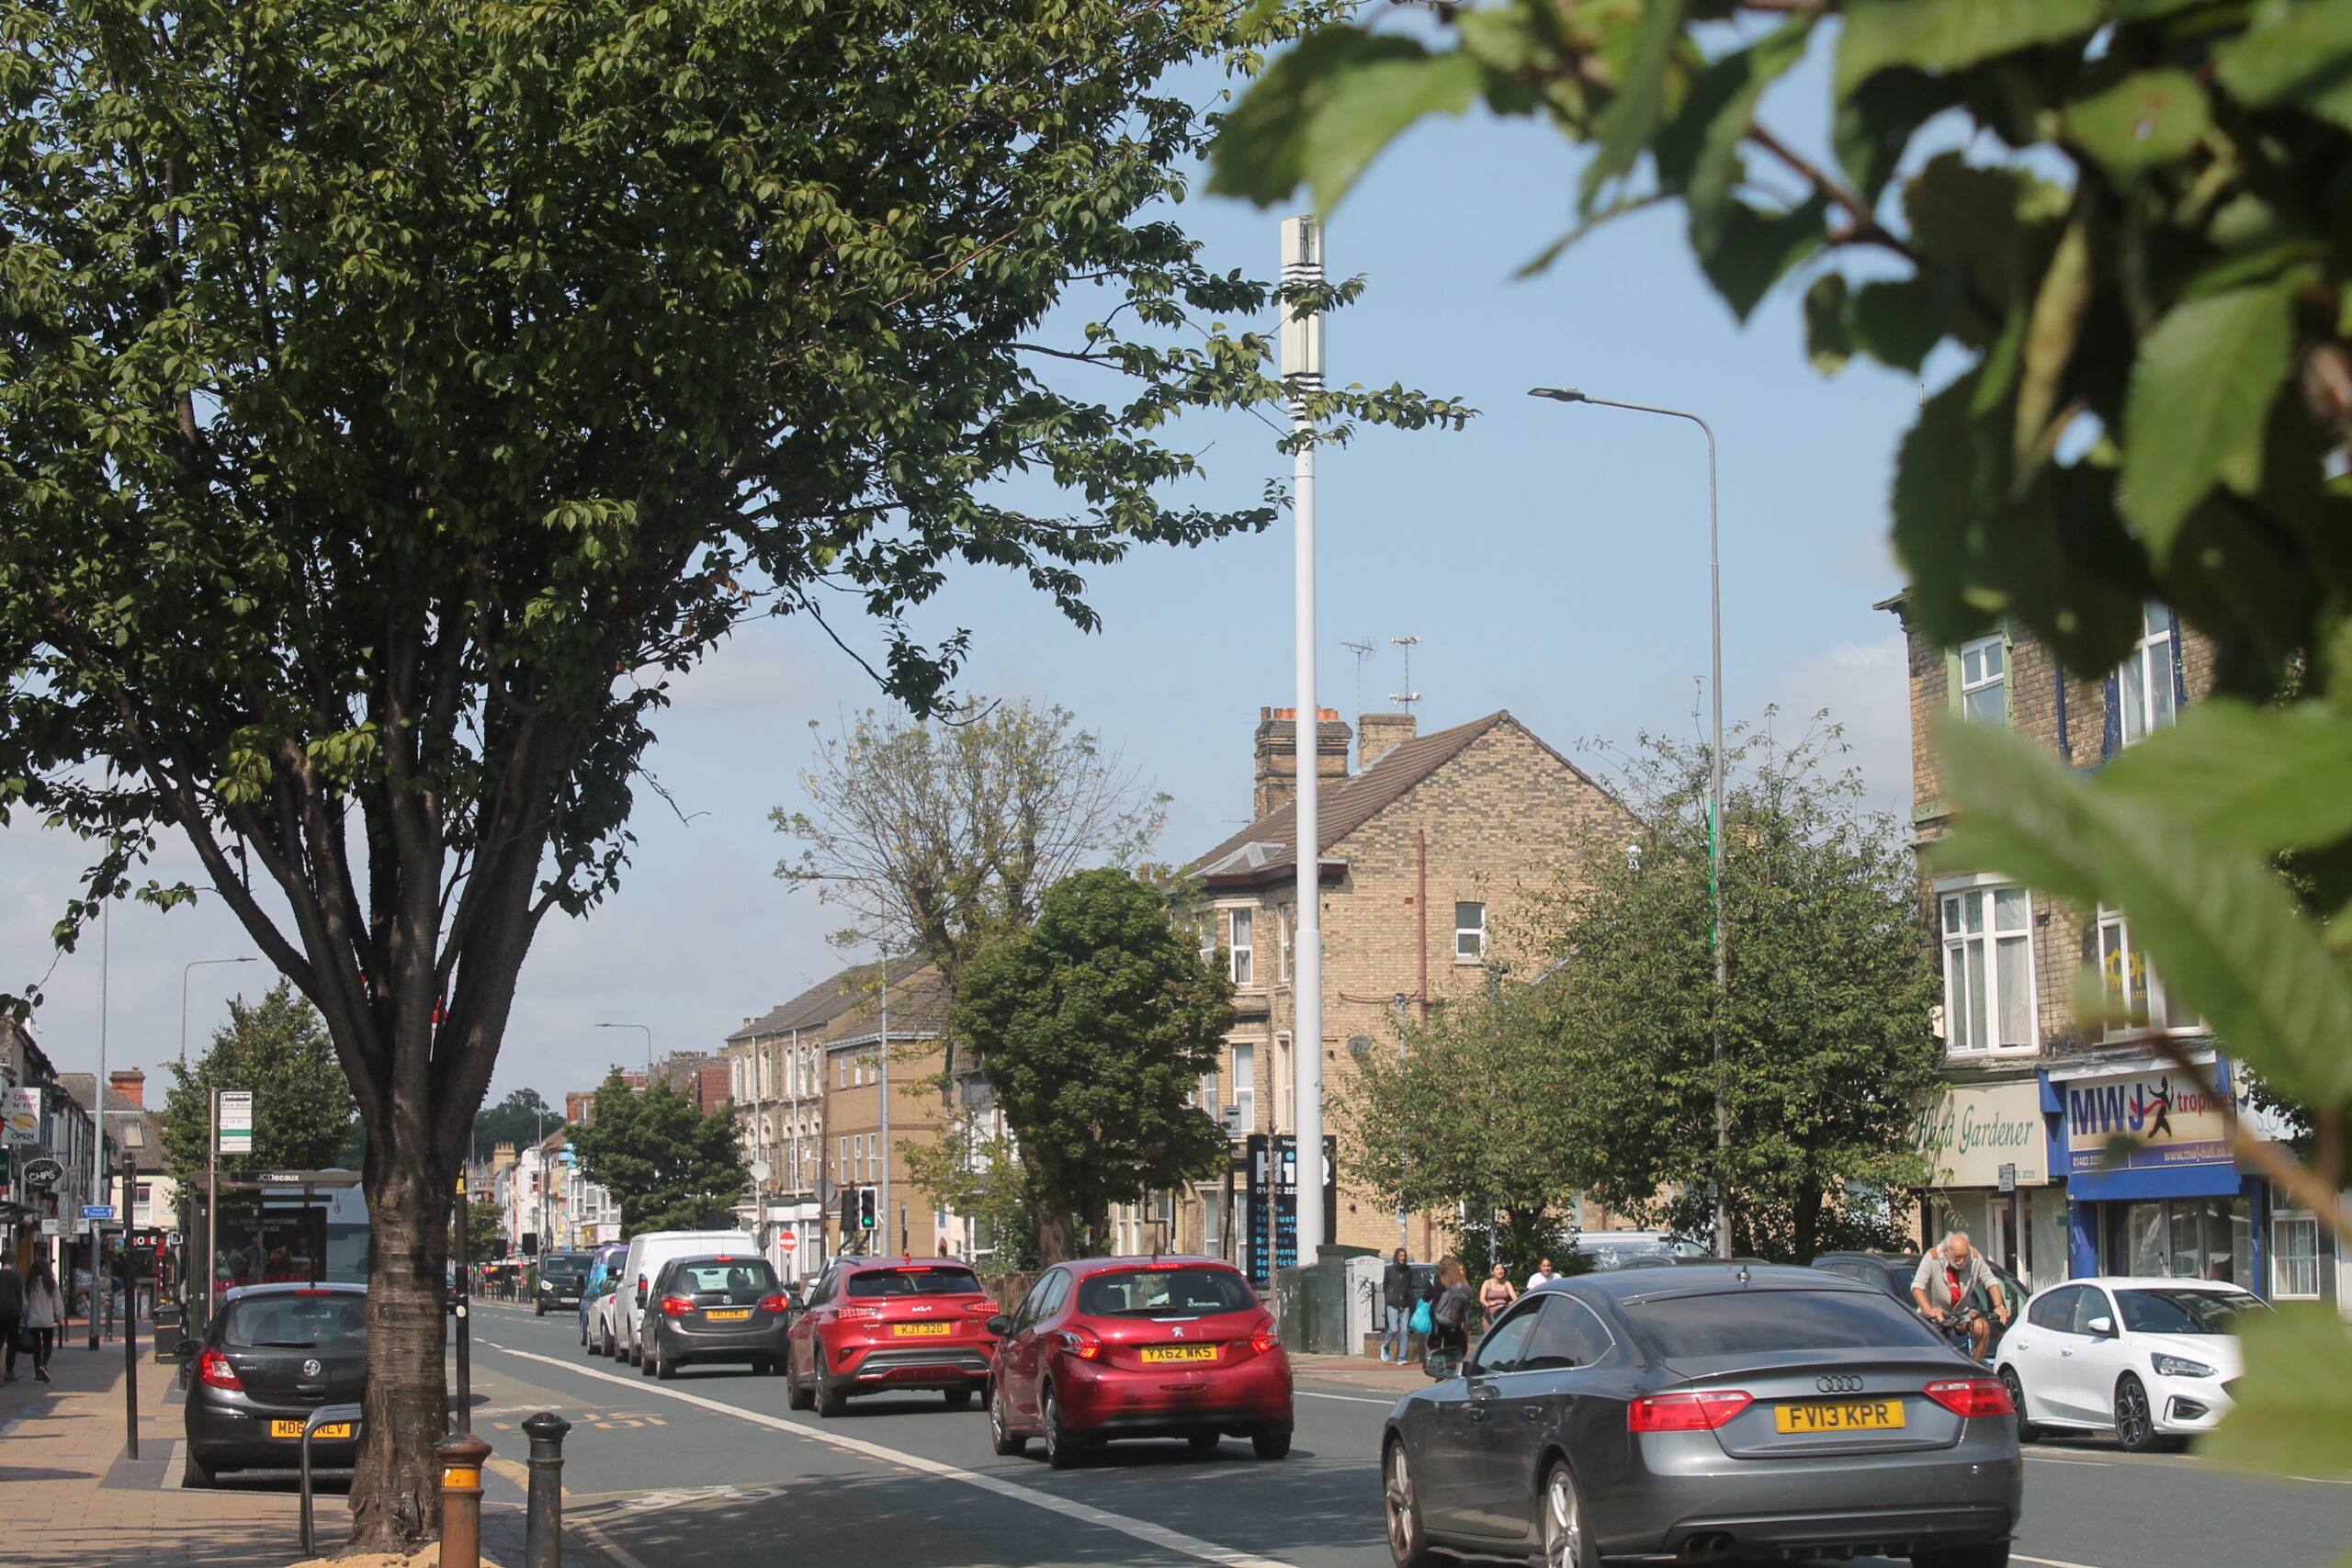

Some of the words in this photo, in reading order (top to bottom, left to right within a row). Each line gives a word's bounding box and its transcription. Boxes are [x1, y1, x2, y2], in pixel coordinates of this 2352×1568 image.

[2070, 1083, 2144, 1136] MWJ
[2177, 1091, 2234, 1117] tropes
[1909, 1104, 1956, 1149] Head
[1959, 1104, 2034, 1155] Gardener
[2164, 1145, 2234, 1162] www.mwj-hull.co.u
[28, 1170, 55, 1181] CHIPS
[257, 1174, 300, 1182] JCDecaux
[901, 1325, 920, 1335] KJT
[924, 1324, 943, 1333] 320
[1148, 1347, 1182, 1359] YX62
[1185, 1346, 1212, 1358] WKS
[1789, 1406, 1838, 1428] FV13
[1845, 1404, 1890, 1426] KPR
[277, 1422, 305, 1434] MD6
[317, 1424, 344, 1435] NEV
